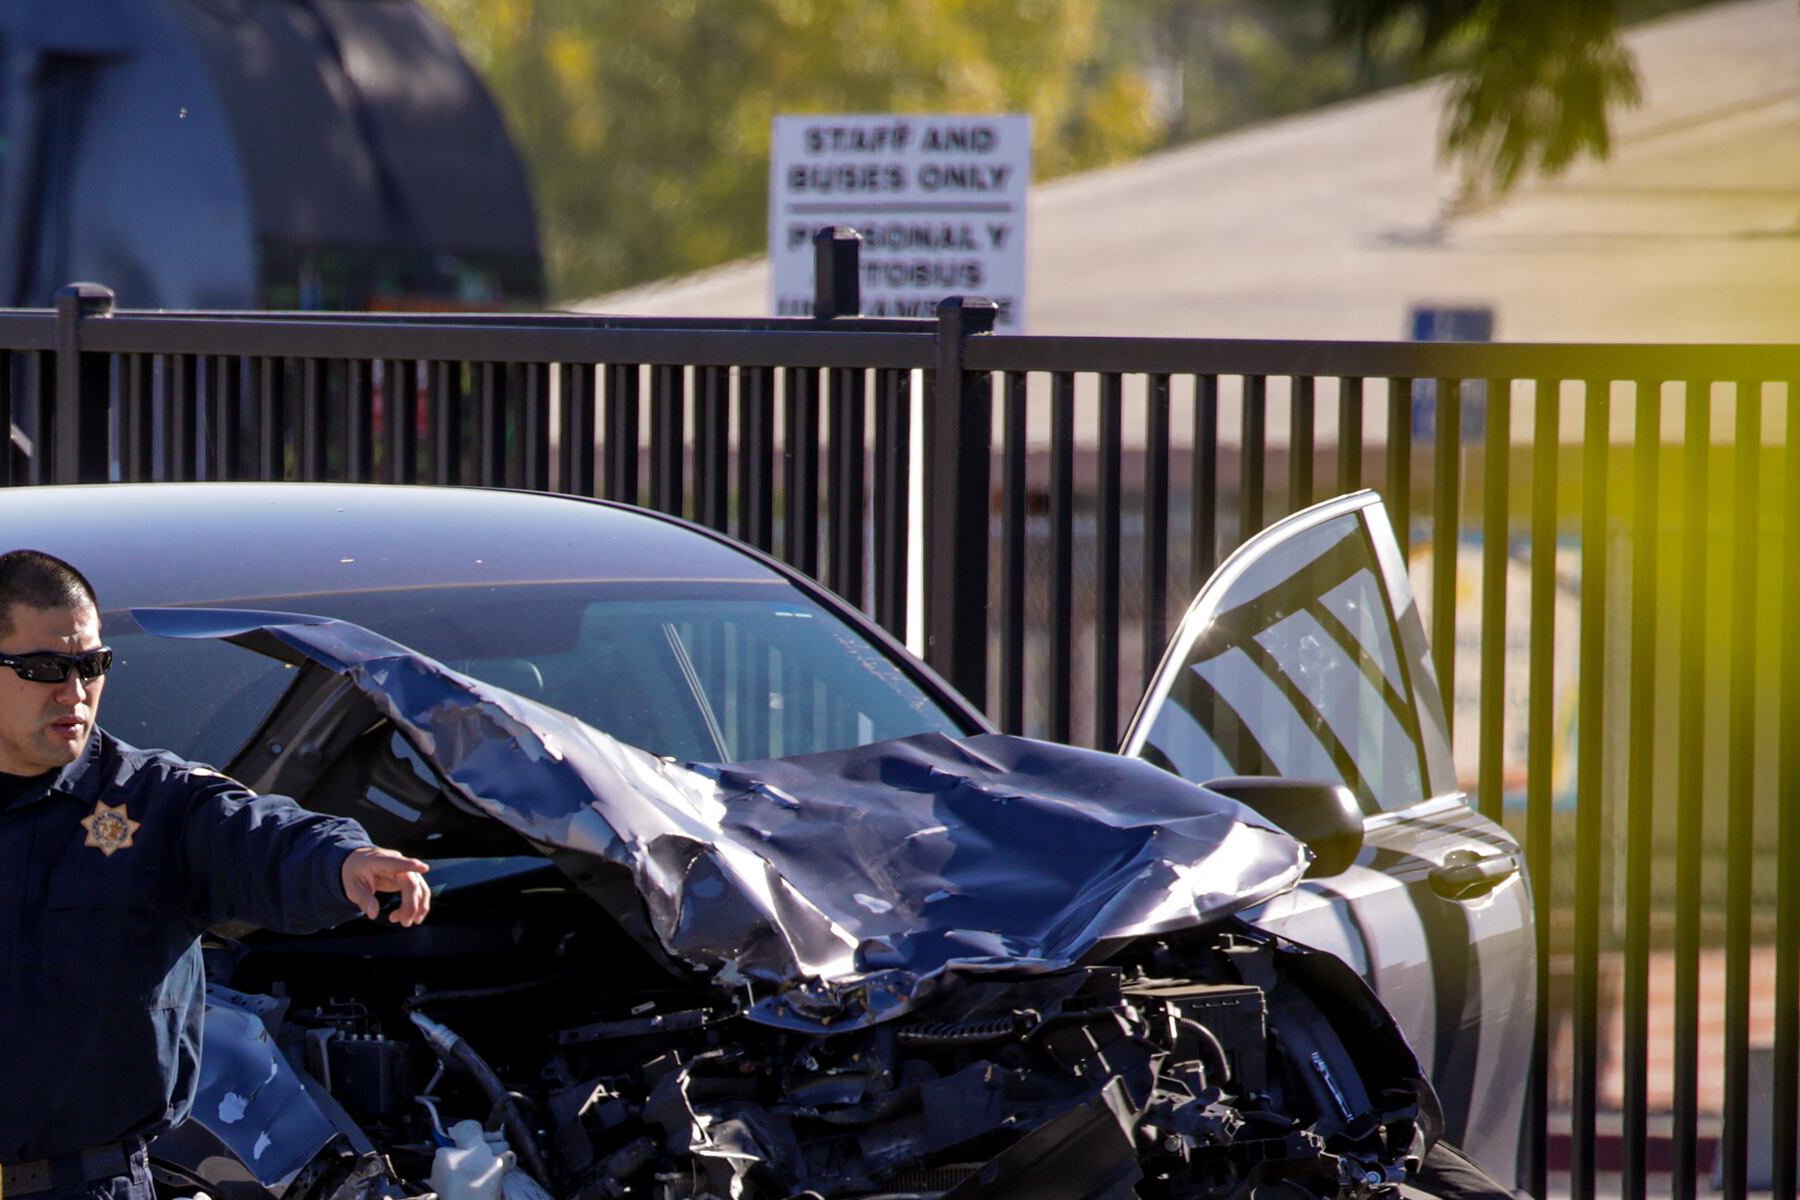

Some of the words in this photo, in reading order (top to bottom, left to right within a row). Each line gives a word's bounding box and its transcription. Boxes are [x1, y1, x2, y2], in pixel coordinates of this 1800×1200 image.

[805, 126, 909, 154] STAFF
[922, 126, 998, 153] AND
[787, 165, 906, 194] BUSES
[917, 164, 1012, 192] ONLY
[787, 222, 979, 251] PSONAL
[986, 223, 1010, 250] Y
[812, 259, 983, 288] TOBUS
